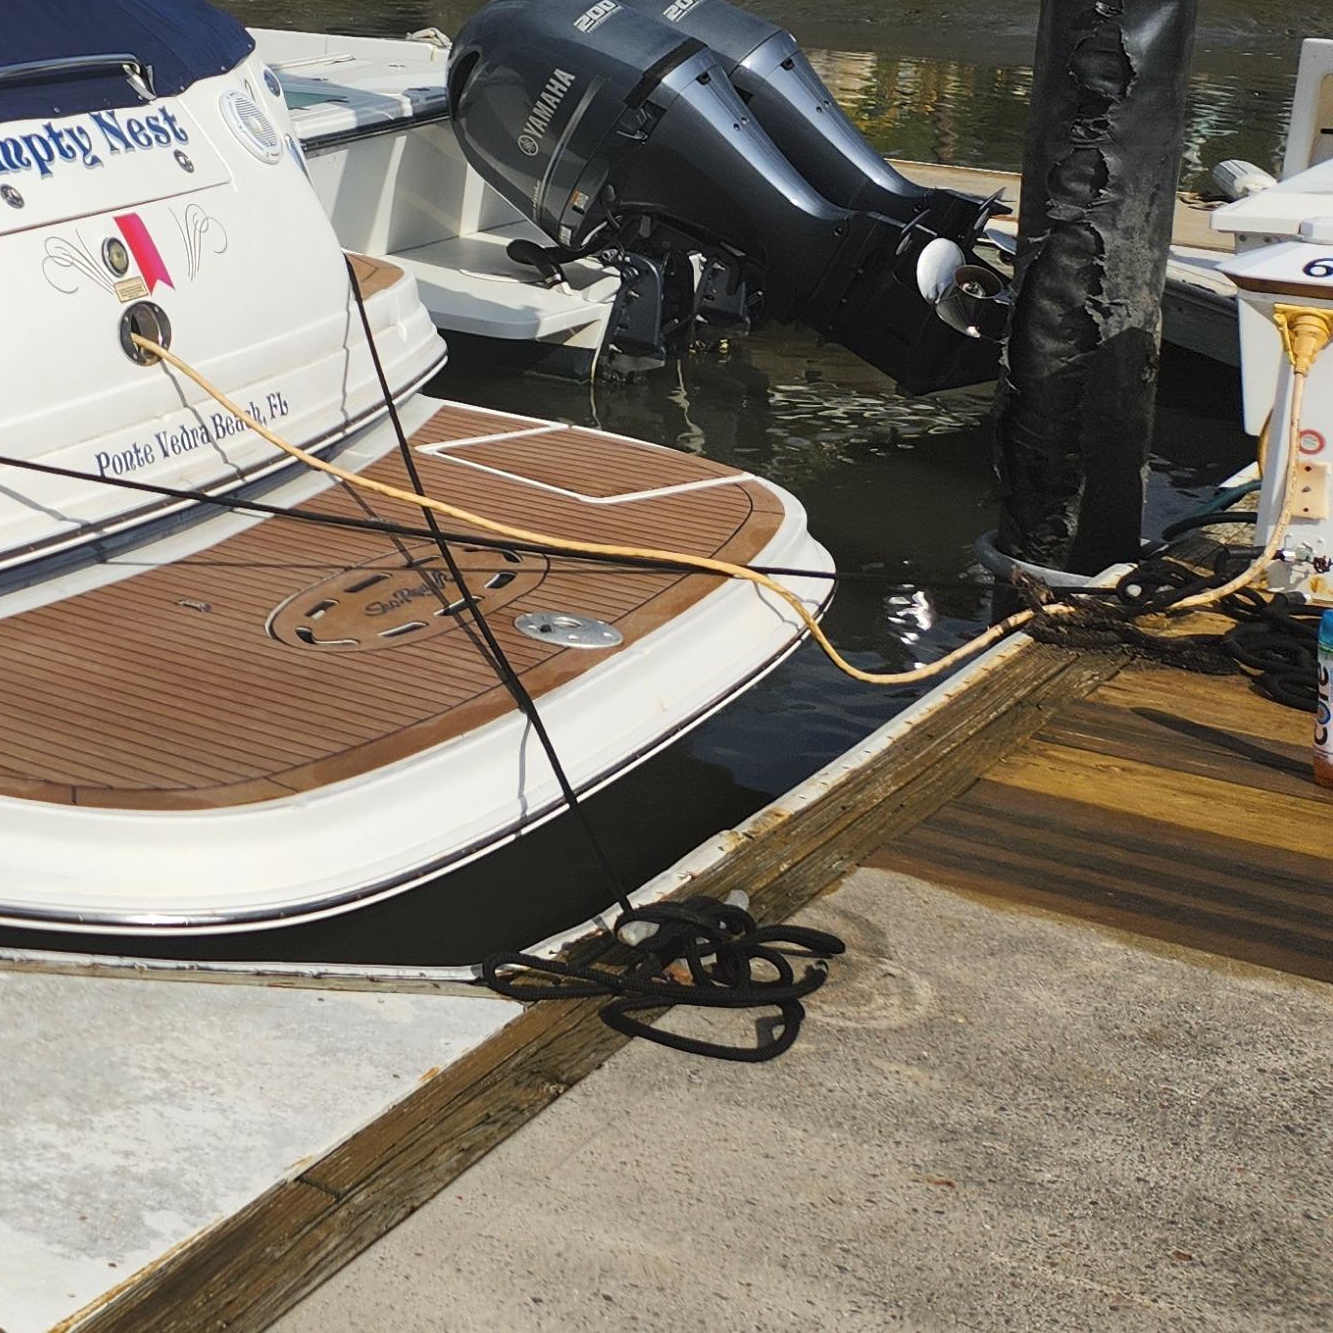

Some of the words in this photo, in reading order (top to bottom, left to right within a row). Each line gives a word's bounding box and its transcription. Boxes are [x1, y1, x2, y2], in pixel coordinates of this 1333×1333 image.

[573, 0, 617, 33] 200
[89, 105, 190, 154] Nest
[523, 68, 576, 139] YAMAHA
[94, 437, 155, 478] Ponte
[154, 424, 212, 459] Vedra
[210, 401, 268, 440] Beah,
